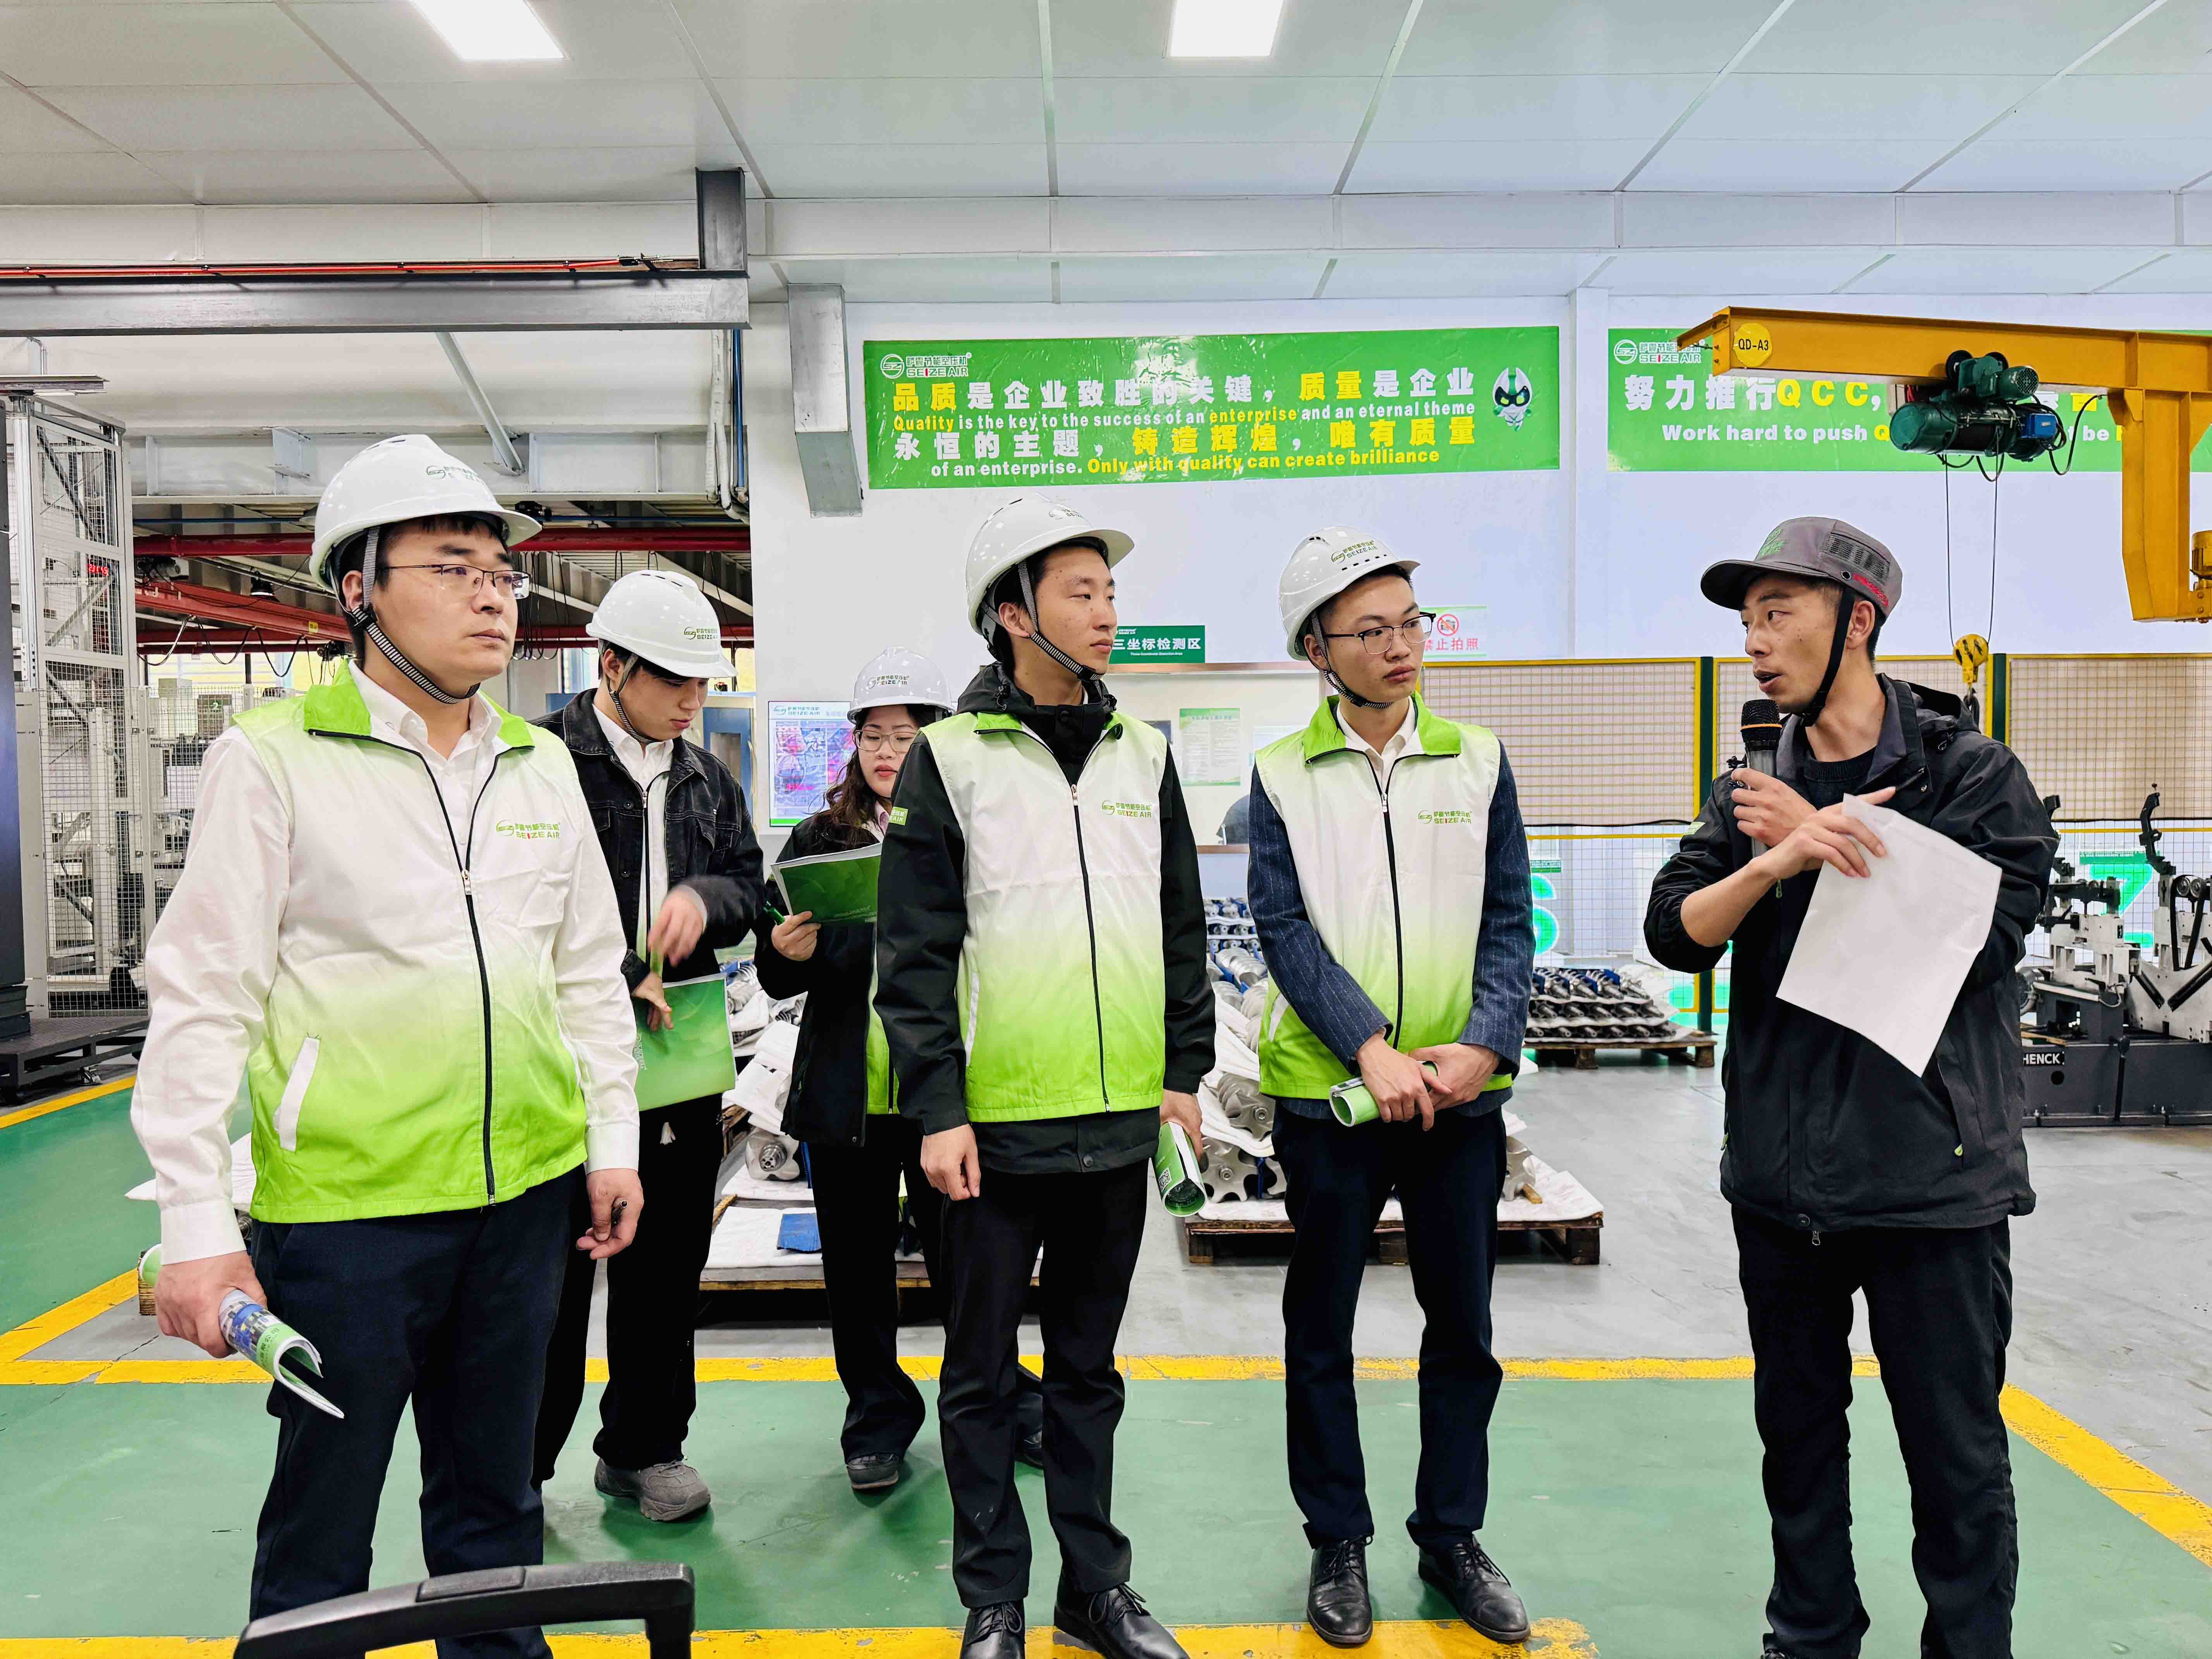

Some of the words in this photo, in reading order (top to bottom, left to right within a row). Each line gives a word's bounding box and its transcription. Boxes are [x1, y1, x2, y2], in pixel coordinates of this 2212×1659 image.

[1738, 337, 1769, 351] QD-A3
[1639, 353, 1679, 363] SEIZE
[1680, 353, 1701, 363] AIR
[907, 367, 946, 377] SEIZE
[947, 366, 969, 377] AIR
[894, 415, 954, 432] Quality
[959, 415, 972, 429] is
[978, 414, 1004, 429] the
[1009, 414, 1035, 431] key
[1042, 414, 1058, 428] to
[1063, 412, 1089, 428] the
[1094, 412, 1161, 427] success
[1166, 409, 1181, 425] of
[1186, 411, 1205, 424] an
[1209, 406, 1297, 424] enterprise
[1302, 405, 1330, 420] and
[1335, 405, 1354, 419] an
[1359, 403, 1419, 418] eternal
[1424, 401, 1475, 416] theme
[1662, 425, 1721, 441] Work
[1727, 424, 1779, 441] hard
[1784, 425, 1808, 441] to
[1814, 424, 1868, 444] push
[2083, 425, 2109, 441] be
[932, 461, 948, 477] of
[954, 463, 975, 476] an
[980, 460, 1082, 478] enterprise.
[1088, 458, 1128, 475] Only
[1133, 456, 1173, 472] with
[1178, 454, 1242, 472] quality
[1248, 456, 1280, 468] can
[1285, 452, 1345, 467] create
[1350, 448, 1440, 465] brilliance
[1346, 547, 1368, 558] SEIZE
[1112, 637, 1201, 651] 三坐标检测区
[2023, 1053, 2060, 1065] HENCK
